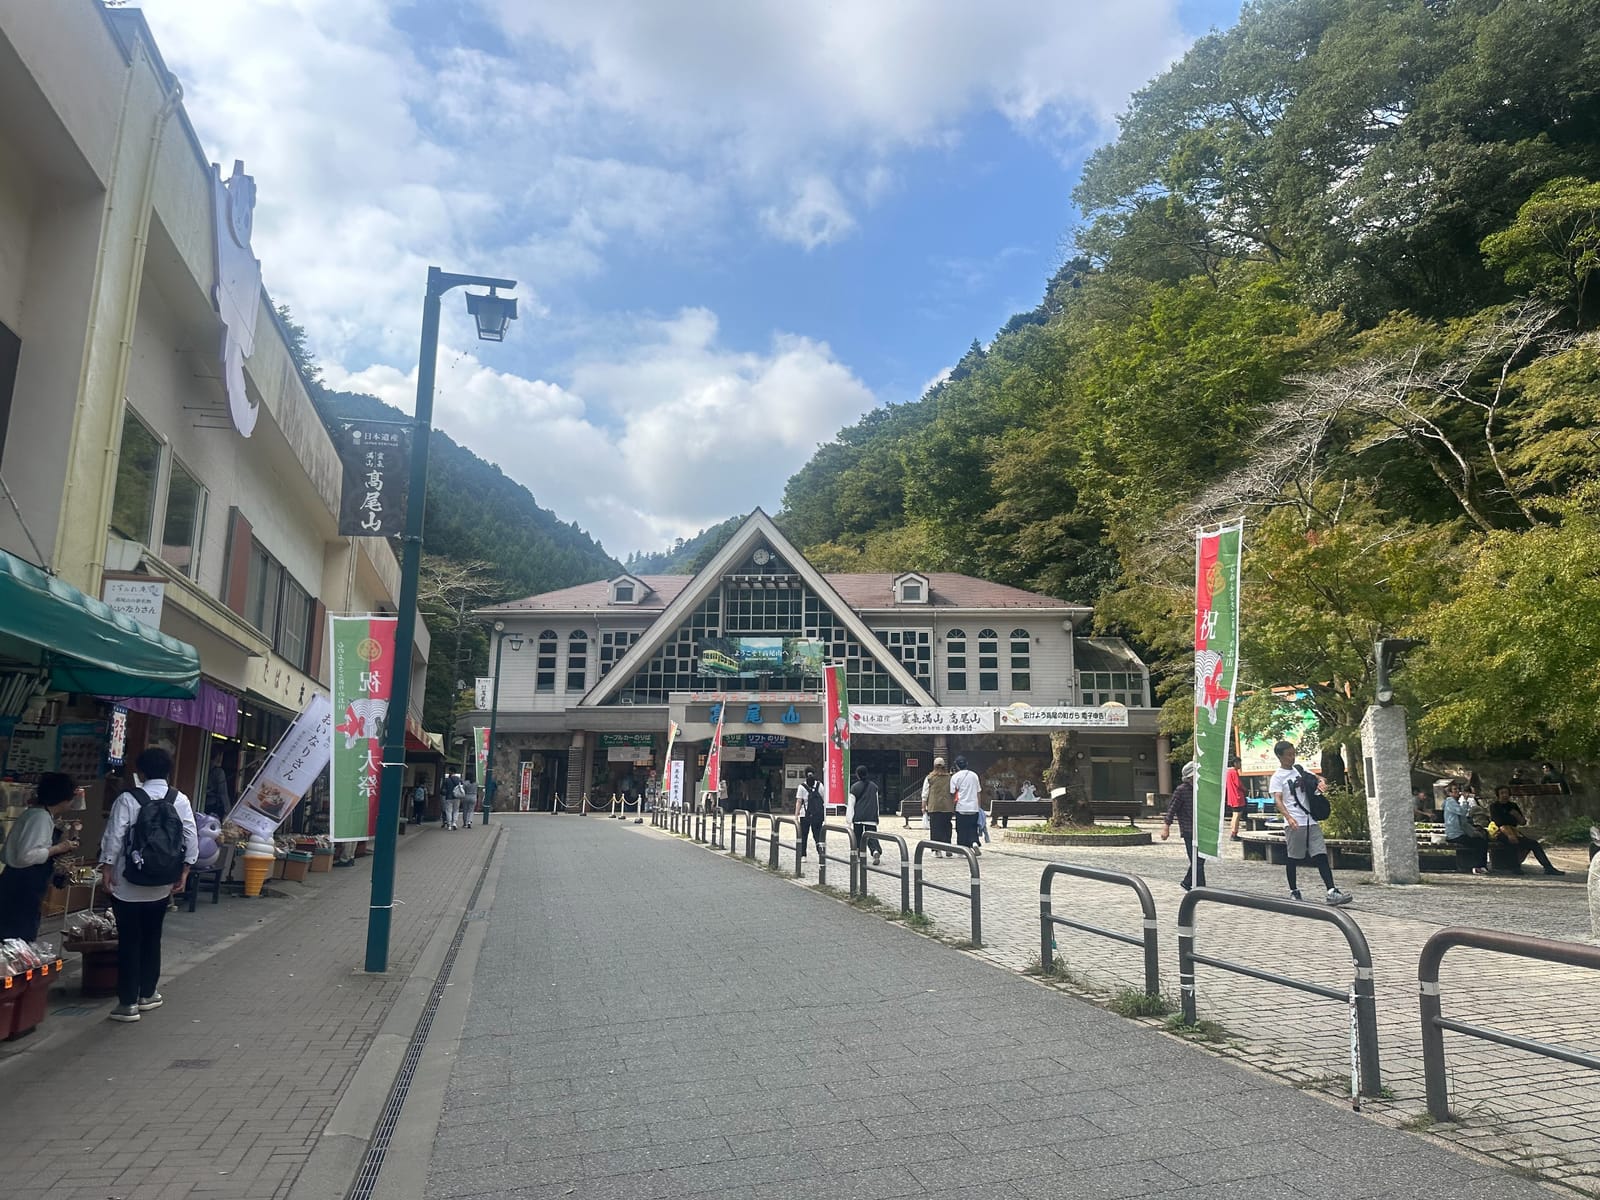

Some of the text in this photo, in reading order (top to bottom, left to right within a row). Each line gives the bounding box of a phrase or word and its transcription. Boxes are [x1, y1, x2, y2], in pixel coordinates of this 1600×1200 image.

[364, 432, 399, 442] 日本遺産
[360, 469, 384, 532] 高尾山
[1200, 608, 1219, 641] 祝
[709, 703, 801, 725] 高尾山
[862, 714, 890, 723] 日本遺産
[949, 712, 981, 725] 高尾山
[748, 734, 786, 742] リフト のりば
